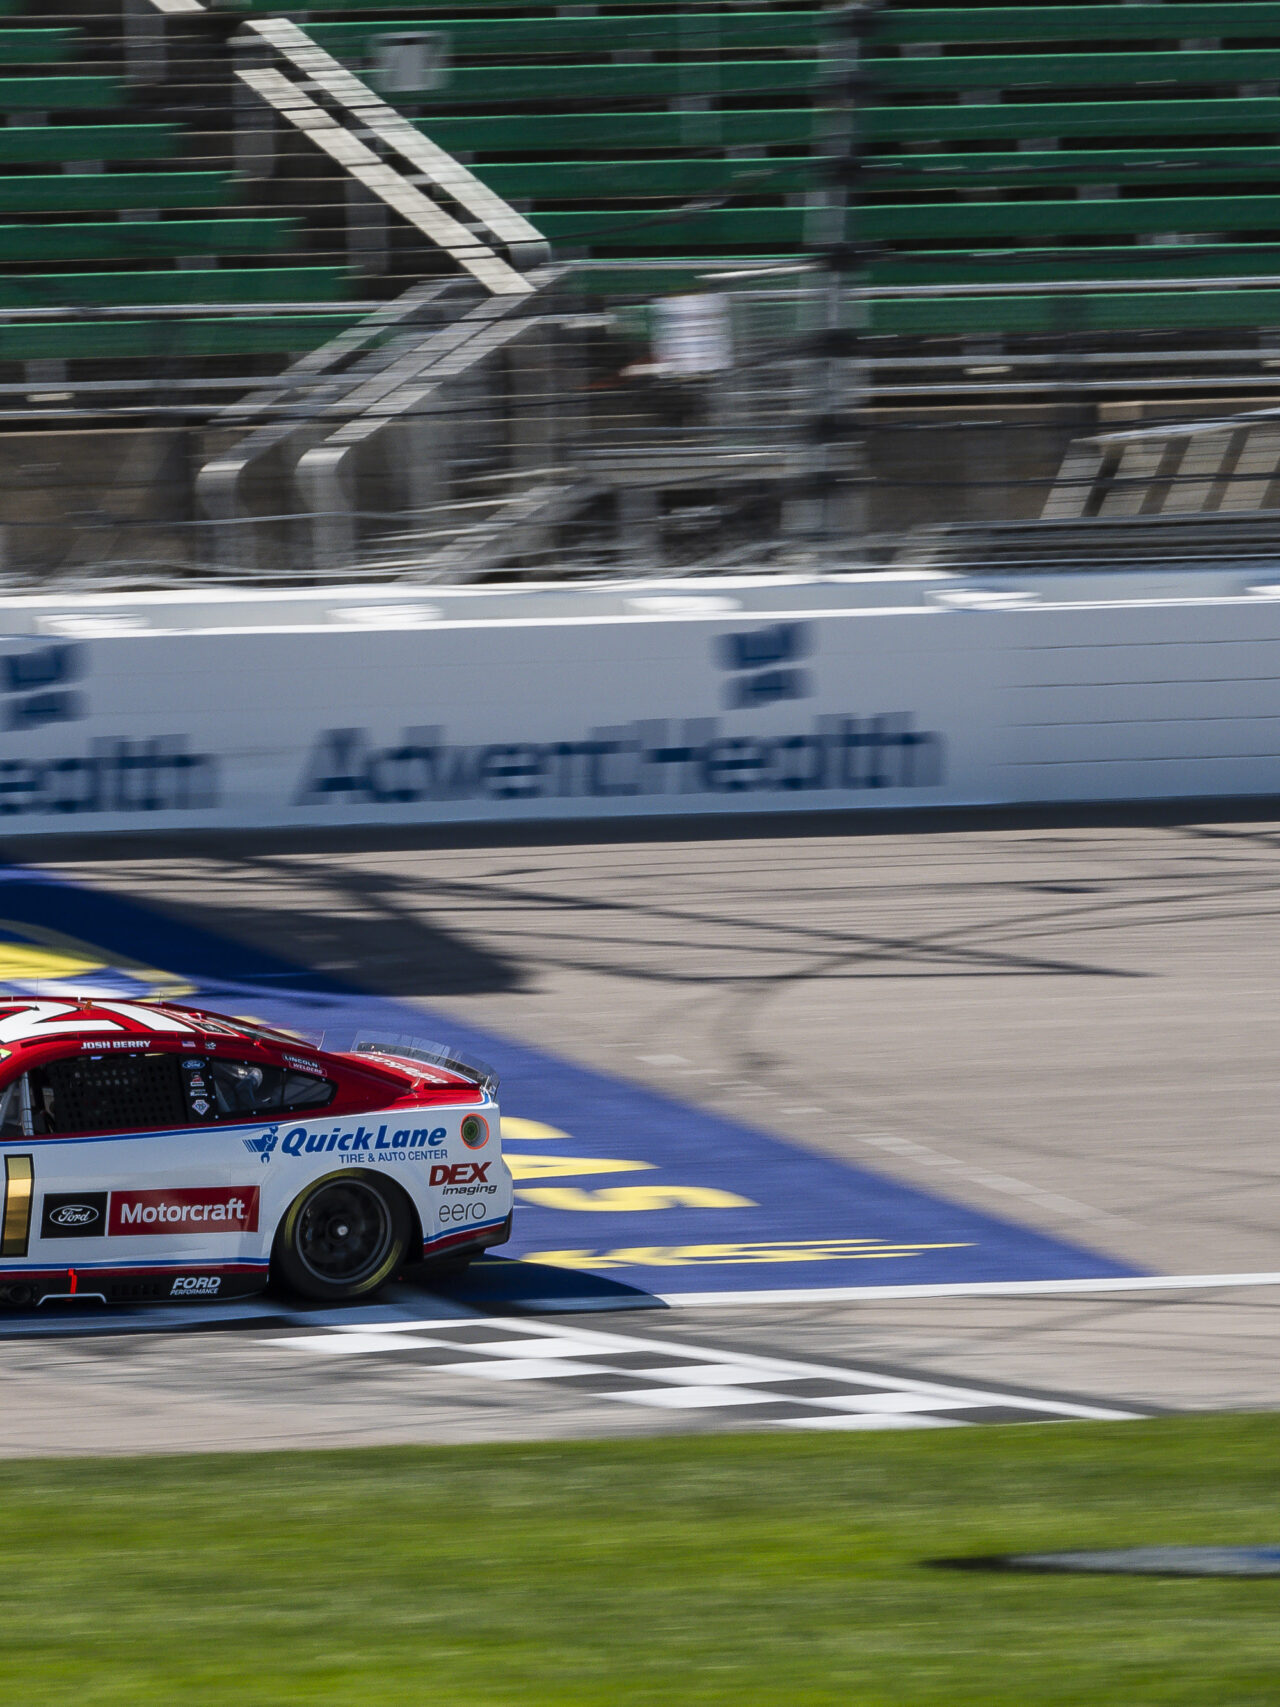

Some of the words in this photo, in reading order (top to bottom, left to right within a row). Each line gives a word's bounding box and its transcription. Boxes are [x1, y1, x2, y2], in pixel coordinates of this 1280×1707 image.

[290, 711, 950, 806] AdventHealth
[81, 1040, 110, 1050] JOSH
[112, 1040, 151, 1049] BERRY
[284, 1055, 318, 1068] LINCOLN
[339, 1153, 365, 1164] TIRE
[369, 1152, 375, 1162] &
[378, 1151, 406, 1162] AUTO
[408, 1149, 448, 1160] CENTER
[429, 1161, 492, 1187] DEX
[442, 1184, 497, 1196] imaging
[58, 1206, 91, 1222] Ford
[120, 1198, 245, 1224] Motorcraft
[439, 1202, 487, 1223] eero
[172, 1277, 222, 1289] FORD
[170, 1287, 219, 1296] PERFORMANCE
